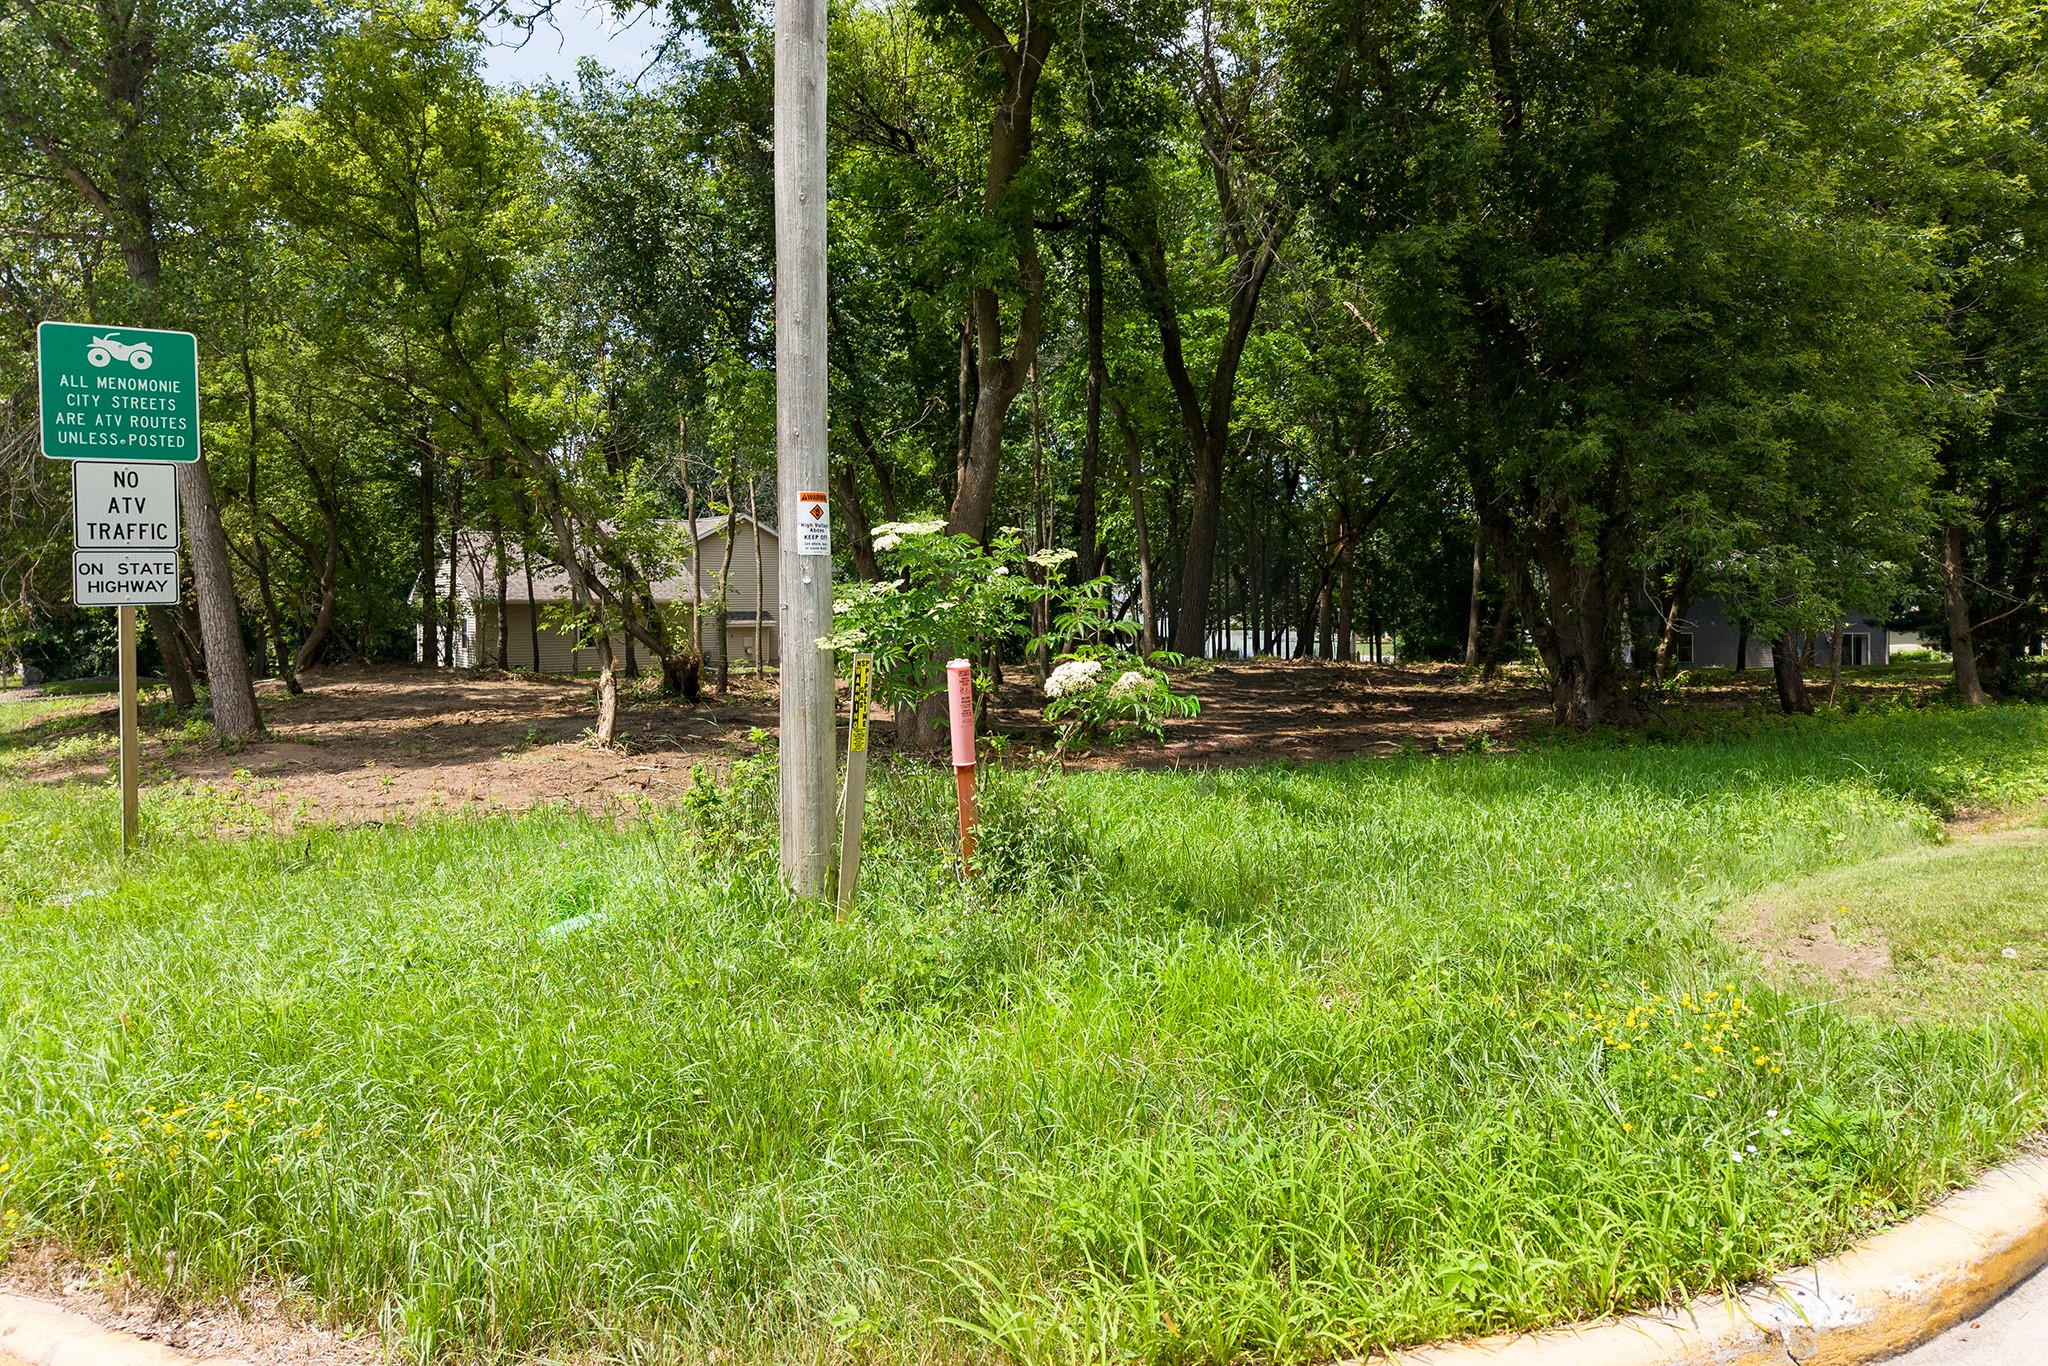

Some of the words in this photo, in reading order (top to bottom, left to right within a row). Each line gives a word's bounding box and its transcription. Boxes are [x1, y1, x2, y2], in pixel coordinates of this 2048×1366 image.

[60, 374, 88, 388] ALL
[97, 377, 181, 393] MENOMONIE
[67, 394, 100, 407] CITY
[112, 396, 176, 411] STREETS
[56, 412, 86, 426] ARE
[96, 414, 123, 427] ATV
[130, 416, 187, 430] ROUTES
[58, 431, 118, 445] UNLESS
[129, 434, 185, 448] POSTED
[114, 471, 139, 488] NO
[108, 497, 146, 514] ATV
[87, 523, 168, 540] TRAFFIC
[78, 563, 104, 576] ON
[118, 563, 175, 576] STATE
[88, 580, 168, 594] HIGHWAY
[853, 667, 861, 728] WARNING
[862, 668, 870, 727] PIPELINE
